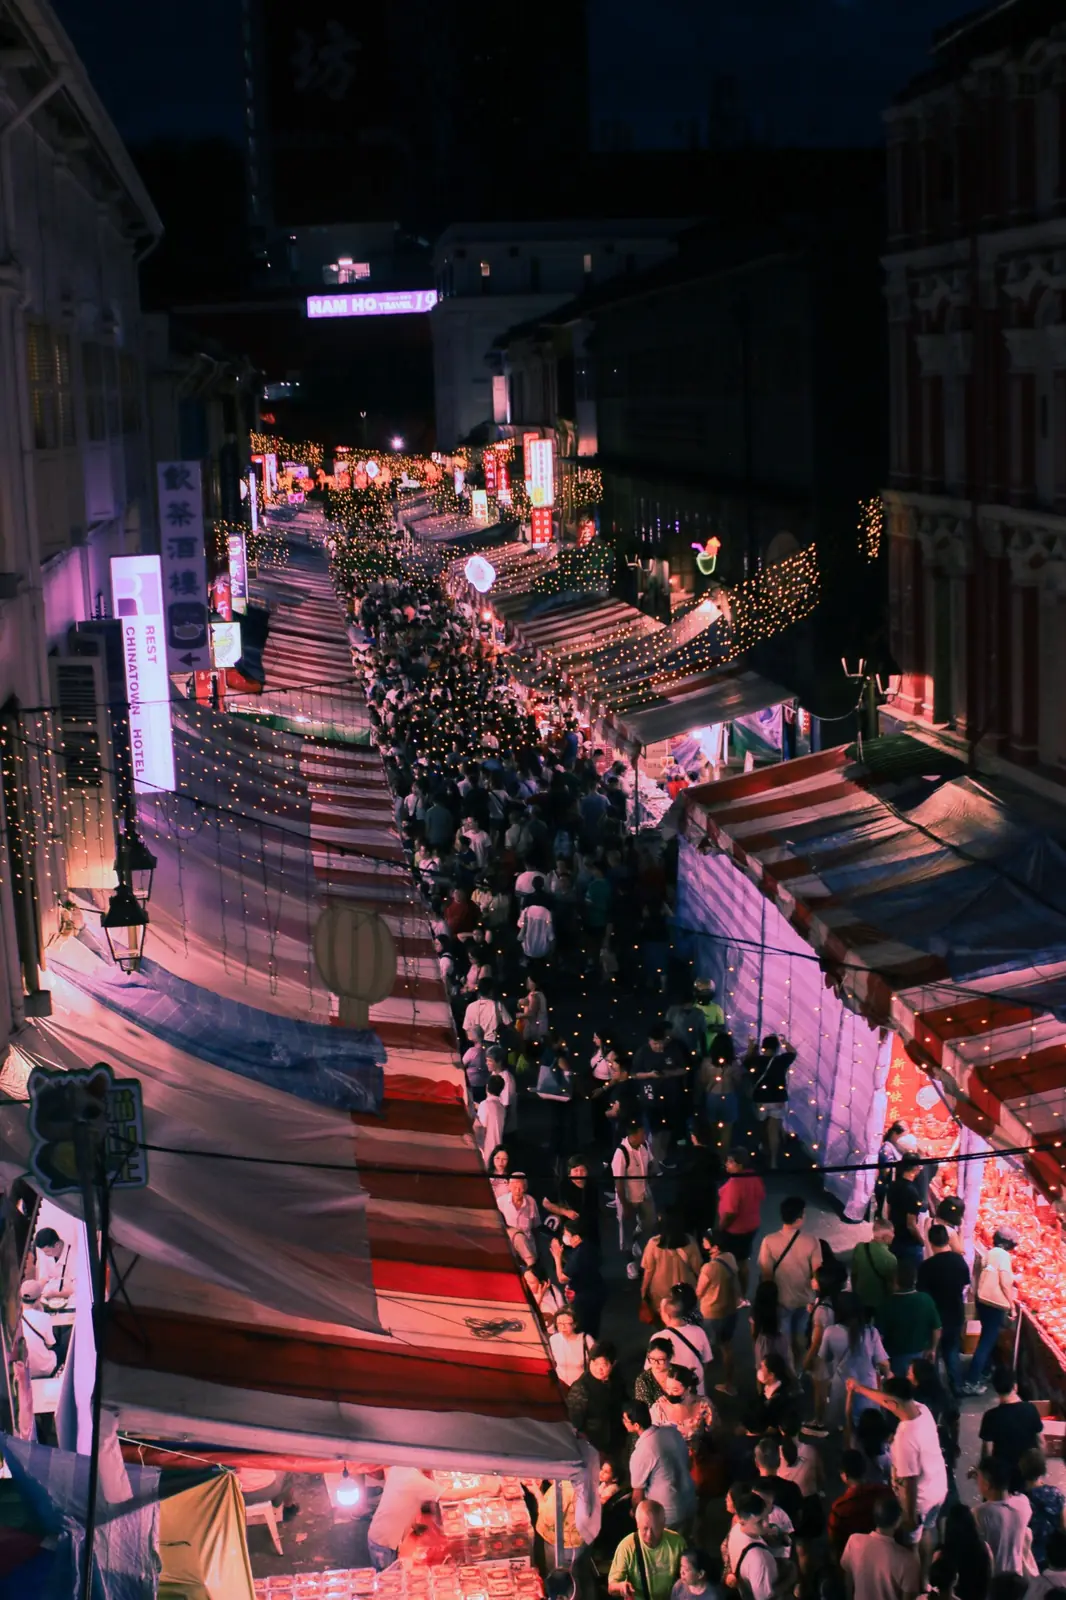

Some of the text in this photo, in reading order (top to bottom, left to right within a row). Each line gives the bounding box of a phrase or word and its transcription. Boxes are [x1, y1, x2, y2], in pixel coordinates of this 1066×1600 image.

[309, 297, 377, 314] NAM HO
[378, 300, 413, 311] TRAVEL
[163, 465, 200, 596] 飲茶酒樓
[145, 625, 158, 664] REST
[126, 626, 145, 777] CHINATOWN HOTEL
